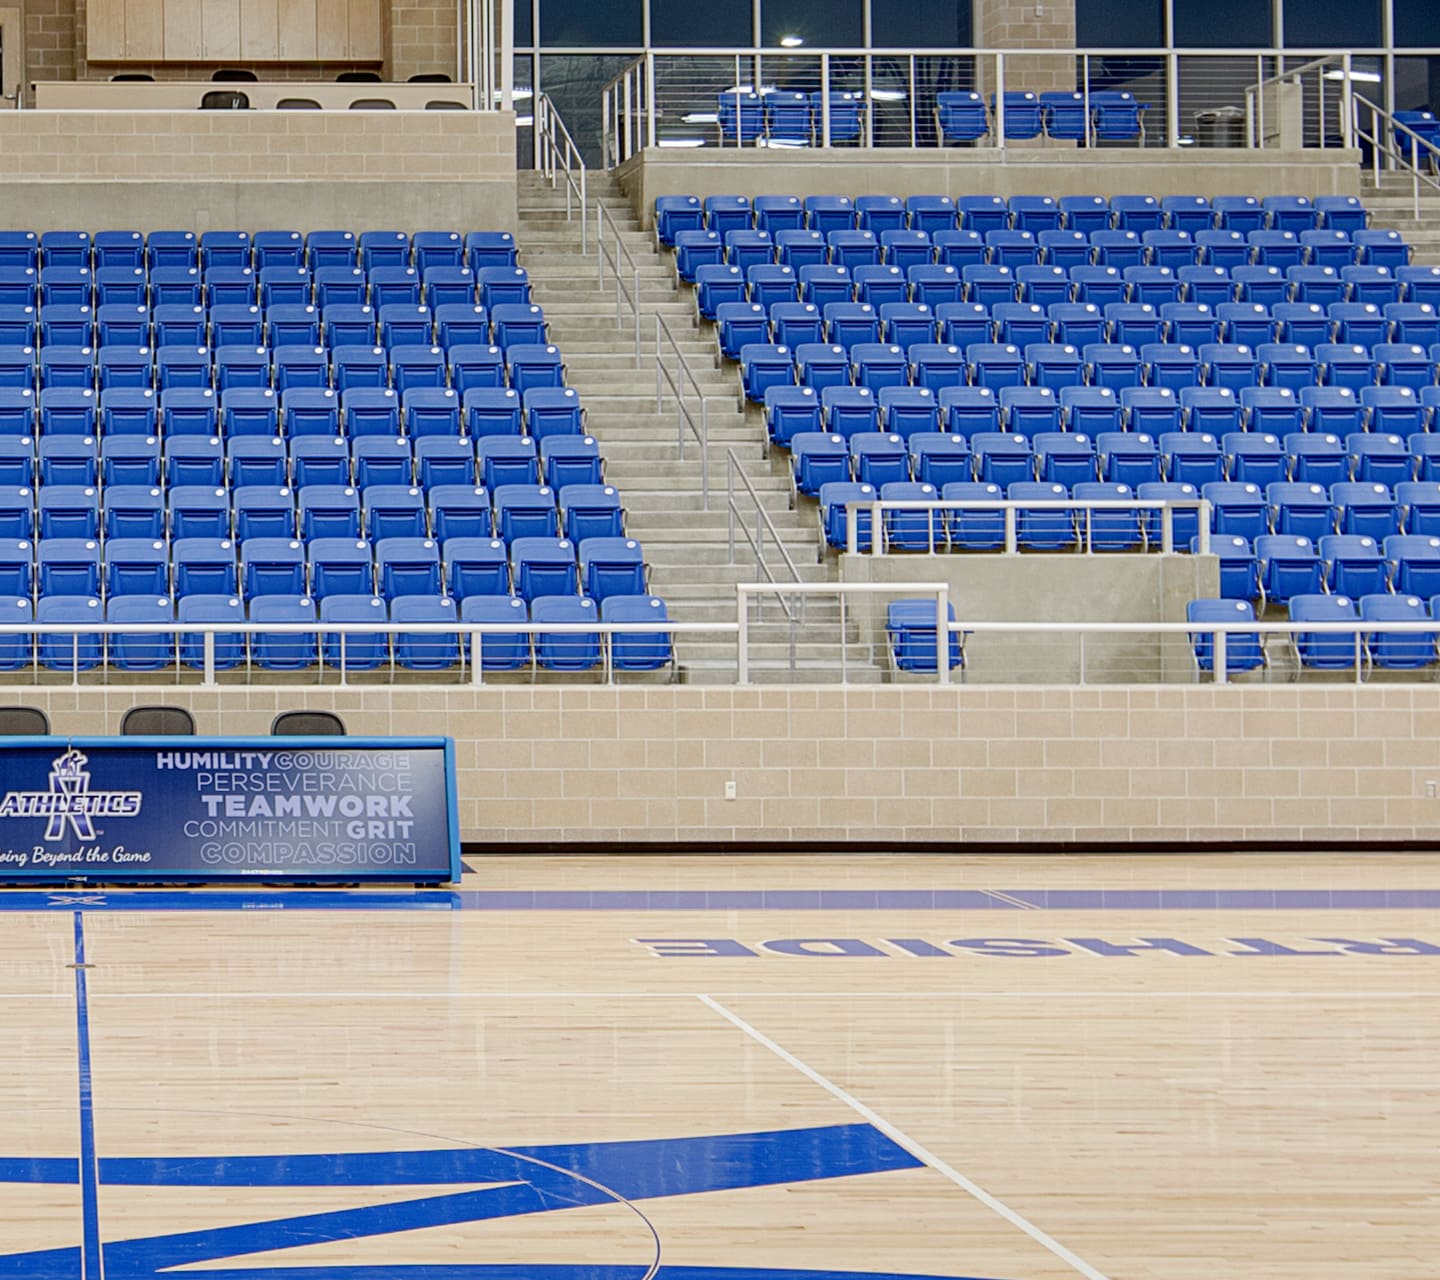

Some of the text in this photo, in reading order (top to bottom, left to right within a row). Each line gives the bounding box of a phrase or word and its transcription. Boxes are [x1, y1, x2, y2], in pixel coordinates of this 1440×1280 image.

[157, 751, 410, 770] HUMILITY COURAGE
[197, 773, 412, 792] PERSEVERANCE
[201, 795, 414, 818] TEAMWORK
[183, 820, 414, 840] COMMITMENT GRIT
[32, 846, 85, 866] Beyond
[86, 847, 109, 863] the
[112, 846, 151, 863] Game
[200, 842, 416, 864] COMPASSION
